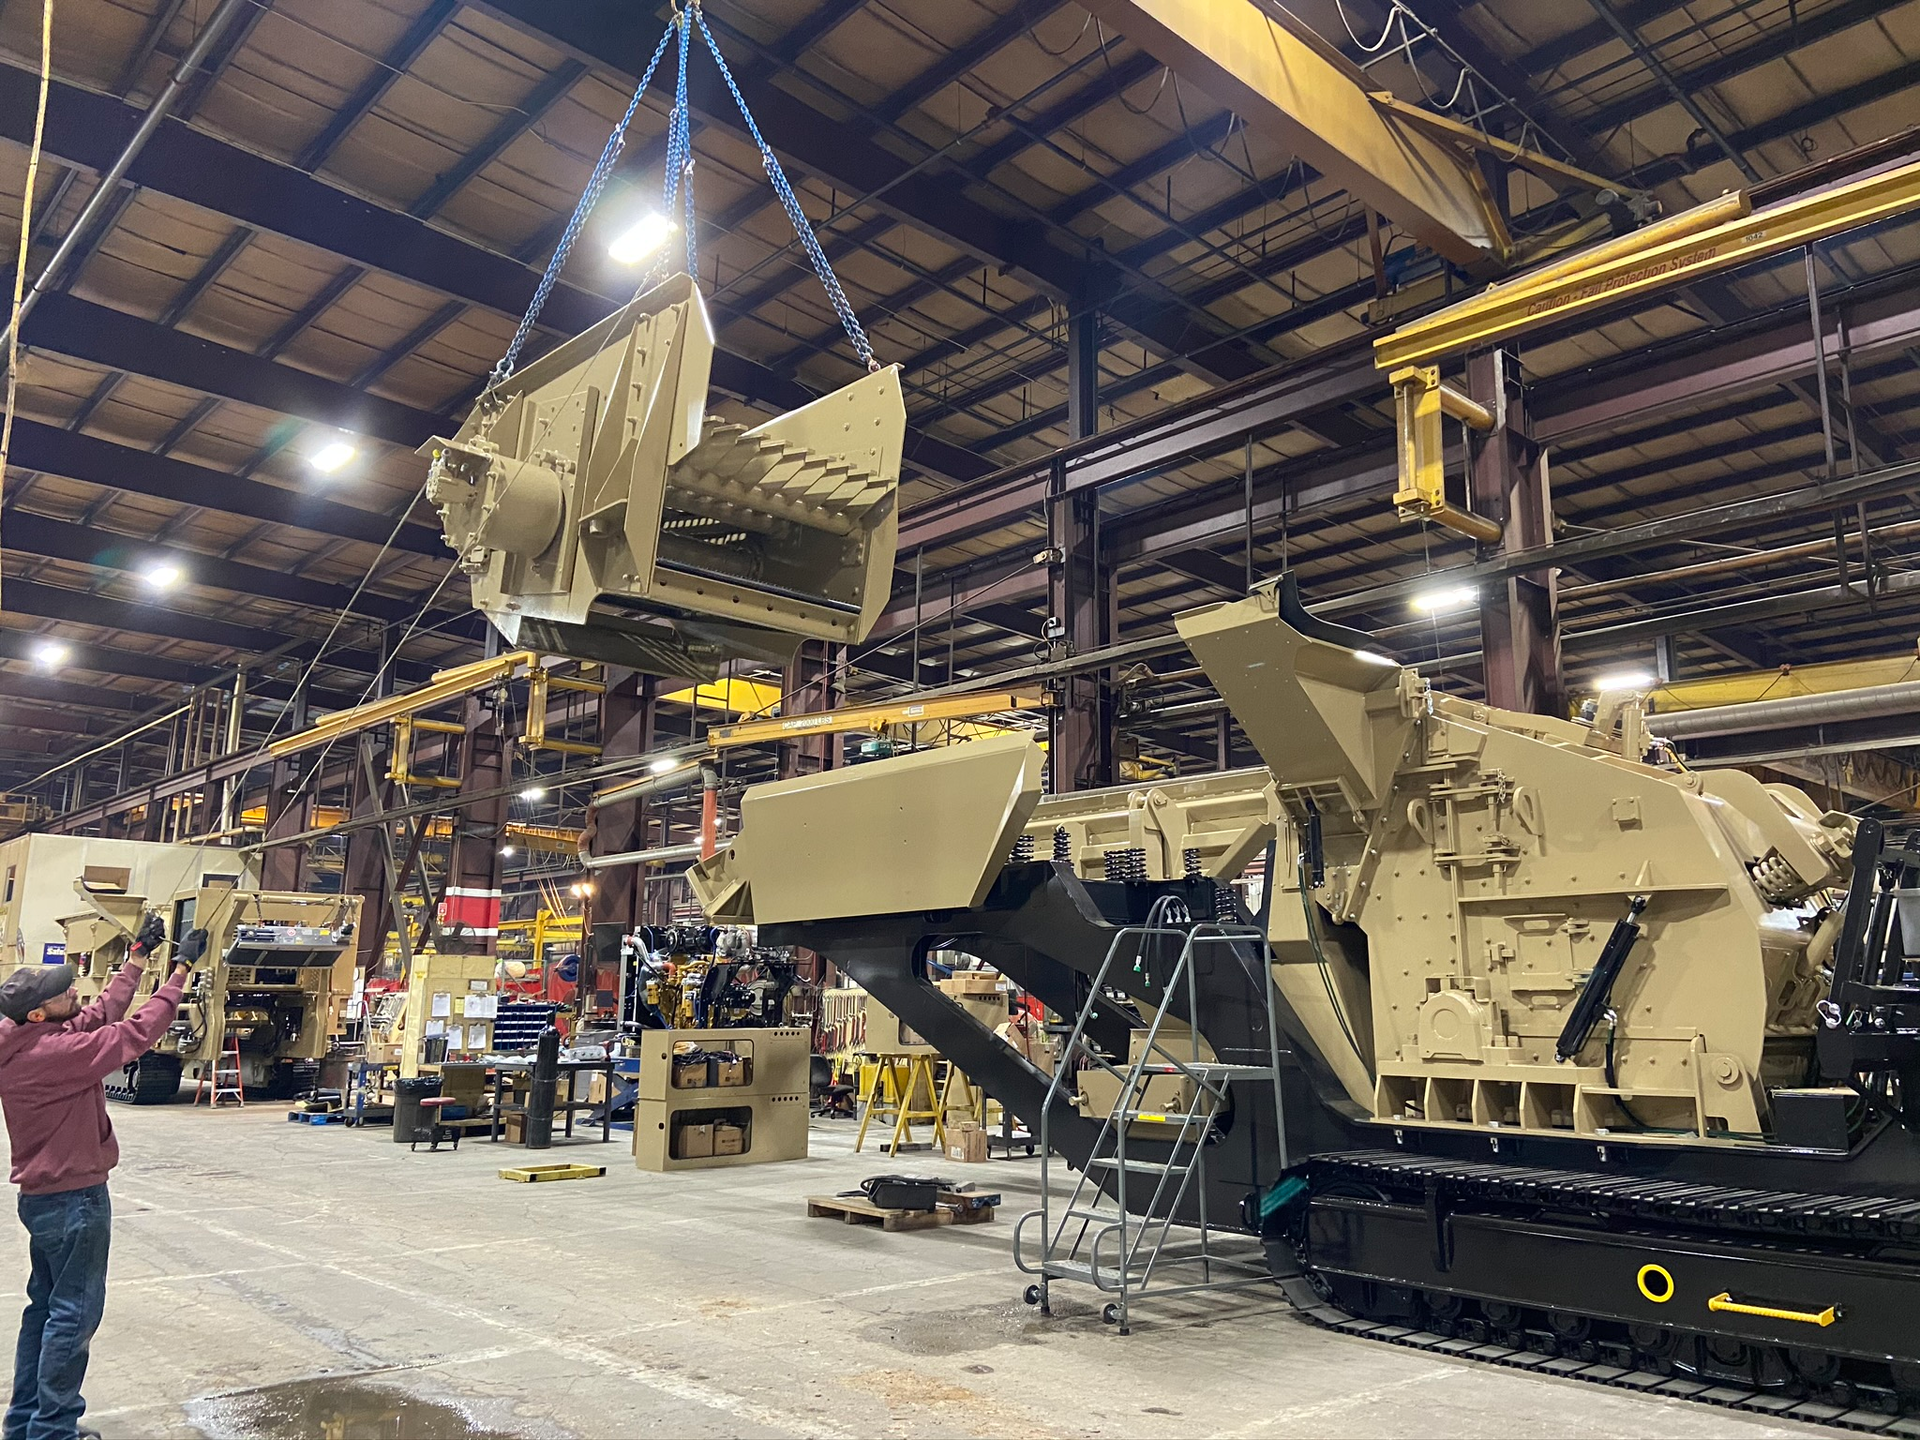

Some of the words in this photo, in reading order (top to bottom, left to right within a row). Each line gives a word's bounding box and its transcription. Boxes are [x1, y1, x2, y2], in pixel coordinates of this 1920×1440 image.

[1527, 294, 1570, 316] Caution
[1580, 282, 1602, 300] Fall
[1603, 262, 1667, 292] Protection
[1669, 247, 1717, 274] System
